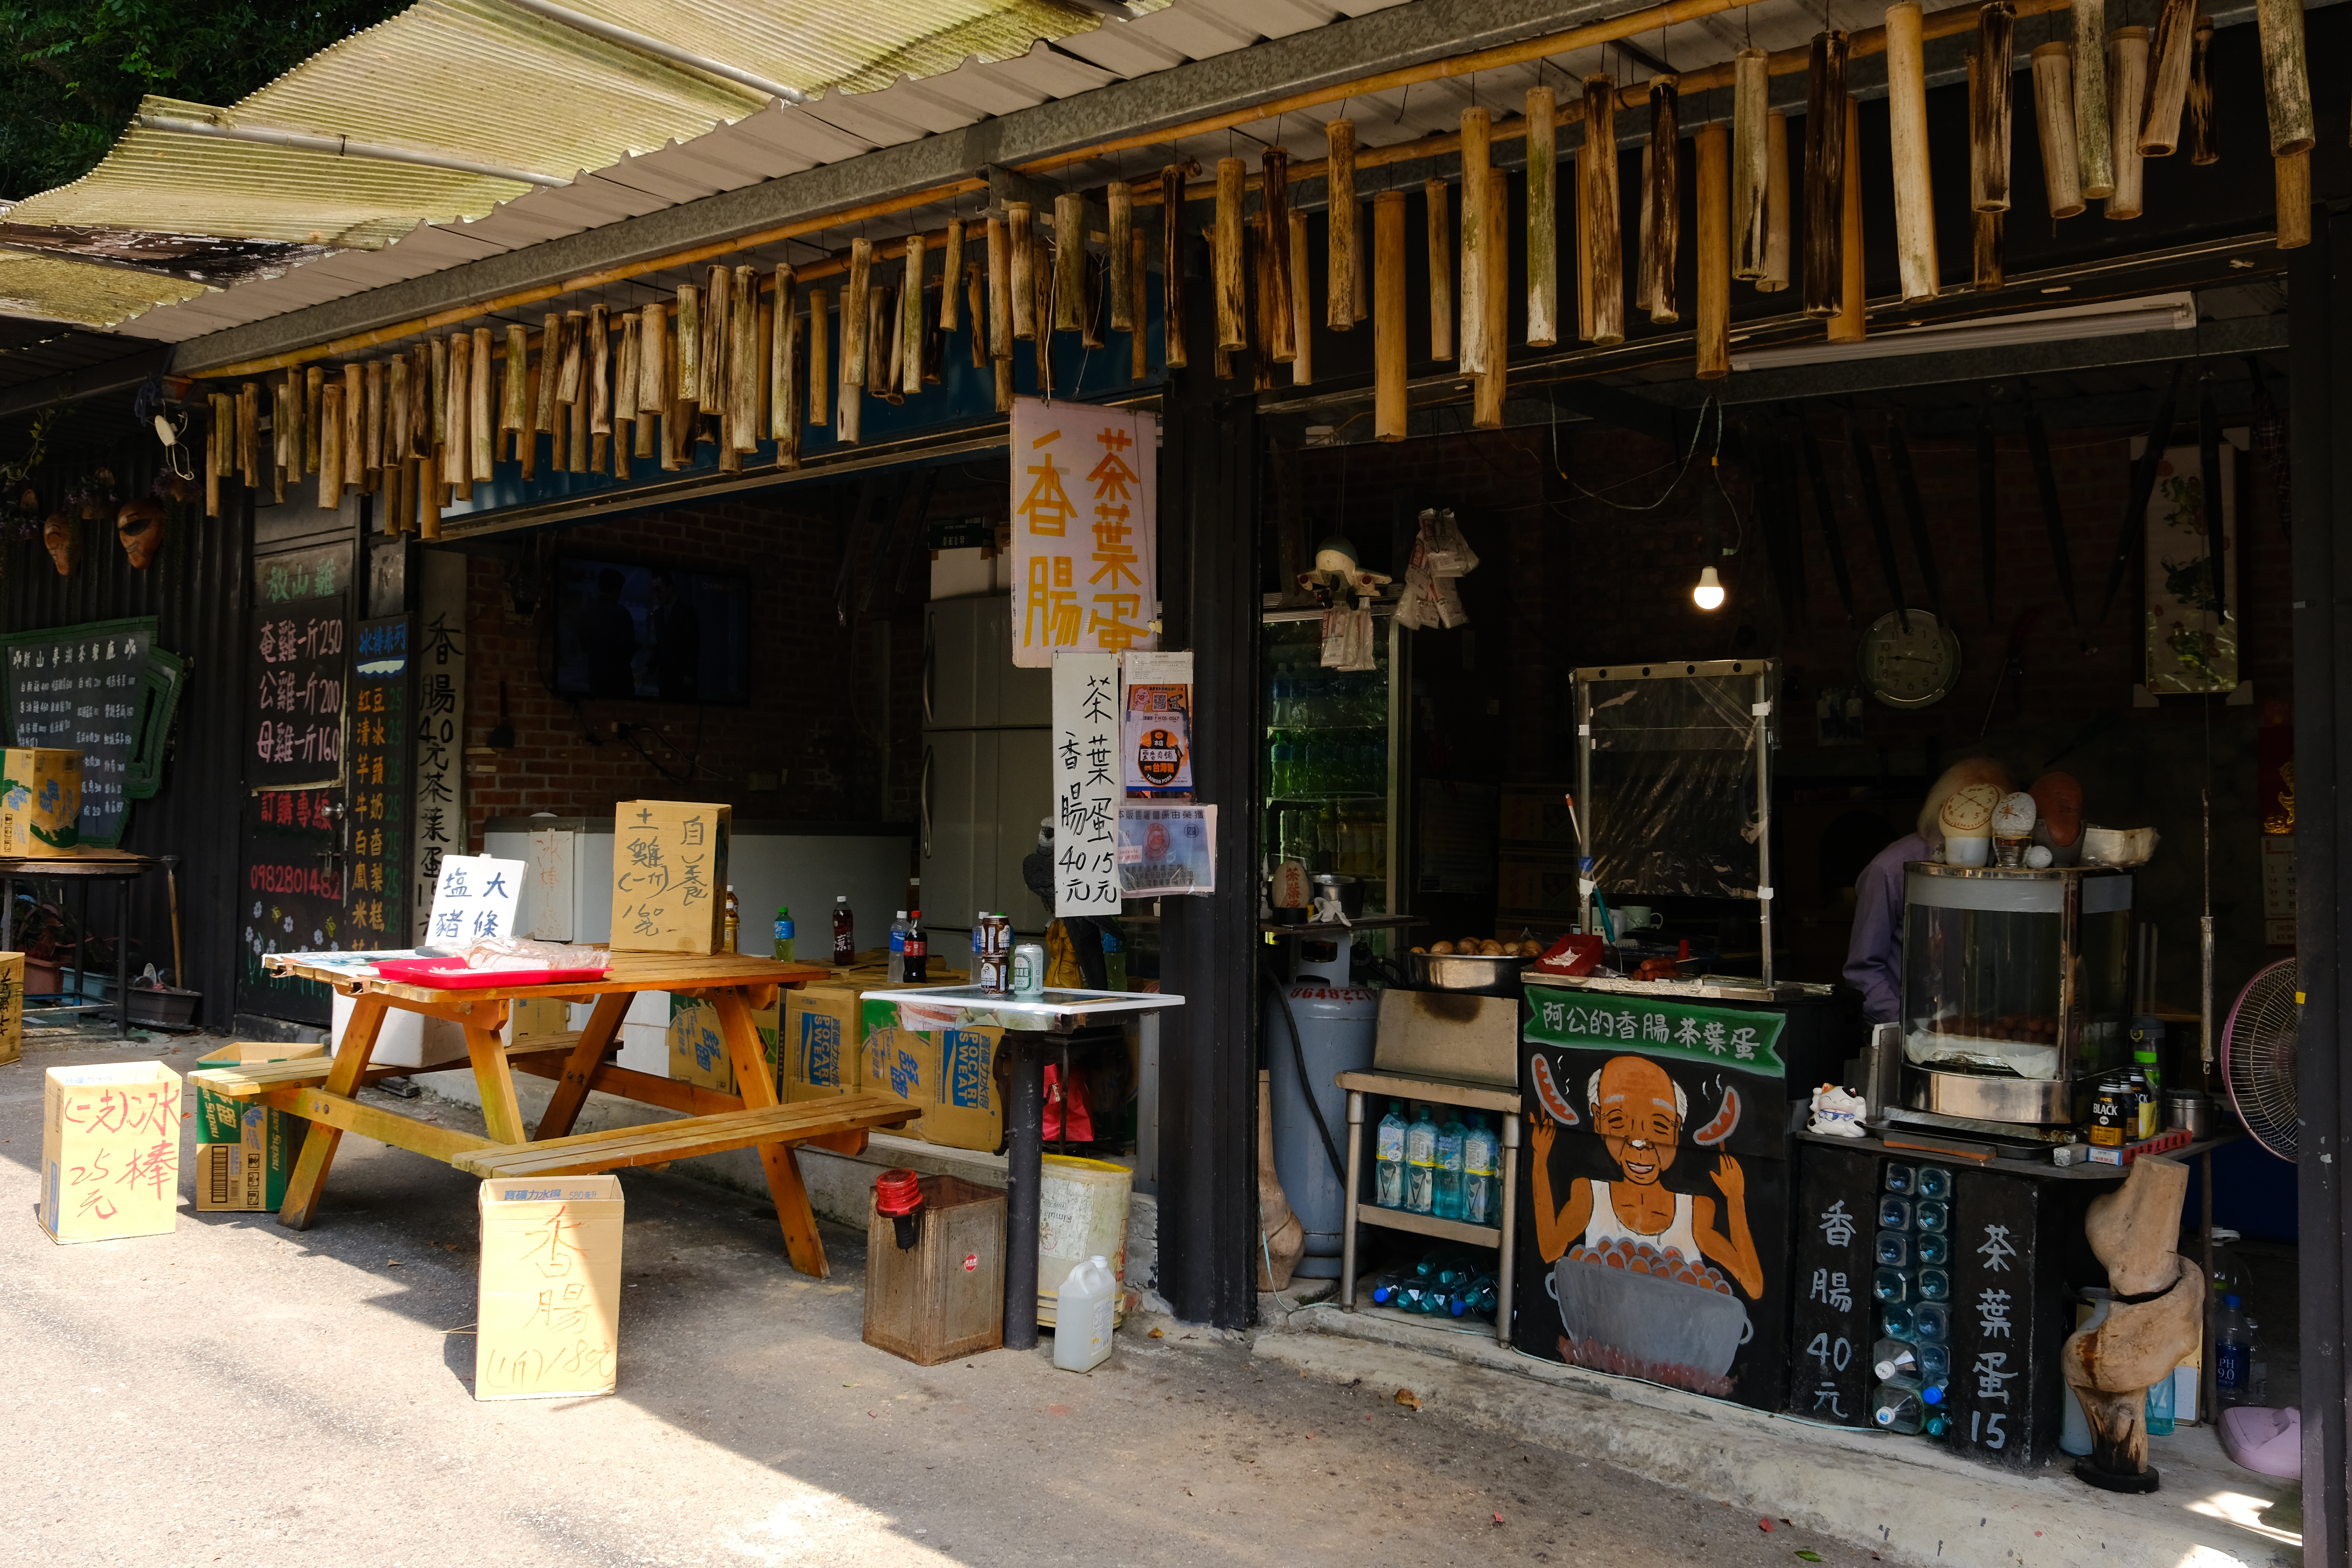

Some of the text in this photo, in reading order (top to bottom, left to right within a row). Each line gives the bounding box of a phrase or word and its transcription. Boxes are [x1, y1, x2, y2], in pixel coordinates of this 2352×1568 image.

[1017, 429, 1083, 648] 香腸
[1086, 428, 1150, 654] 茶葉蛋
[266, 558, 335, 603] 放山雞
[357, 686, 403, 713] 紅豆 25
[356, 717, 402, 747] 清水 25
[356, 753, 401, 786] 芋頭 25
[1082, 675, 1117, 903] 茶葉蛋15元
[1146, 773, 1173, 784] TAIWAN PORK
[354, 792, 400, 823] 牛奶 25
[1058, 731, 1090, 903] 香腸40元
[355, 827, 400, 862] 百香 25
[666, 815, 709, 906] 自養
[250, 864, 342, 900] 0982801482
[384, 866, 400, 899] 25
[473, 872, 509, 937] 大條
[352, 898, 400, 934] 米糕 25
[813, 1015, 822, 1080] SWEAT
[821, 1015, 831, 1087] POCARI
[1543, 1002, 1761, 1060] 阿公的香腸茶葉蛋
[890, 1048, 920, 1099] 舒跑
[957, 1032, 969, 1100] SWEAT
[966, 1033, 979, 1108] POCARI
[205, 1101, 220, 1138] Supau
[2093, 1102, 2118, 1116] BLACK
[115, 1081, 182, 1201] 冰棒
[271, 1133, 281, 1171] Supau
[519, 1205, 592, 1334] 香腸
[1806, 1199, 1857, 1418] 香腸40元
[1971, 1224, 2018, 1449] 茶葉蛋15
[2218, 1367, 2235, 1380] 9.0
[2219, 1357, 2234, 1369] PH
